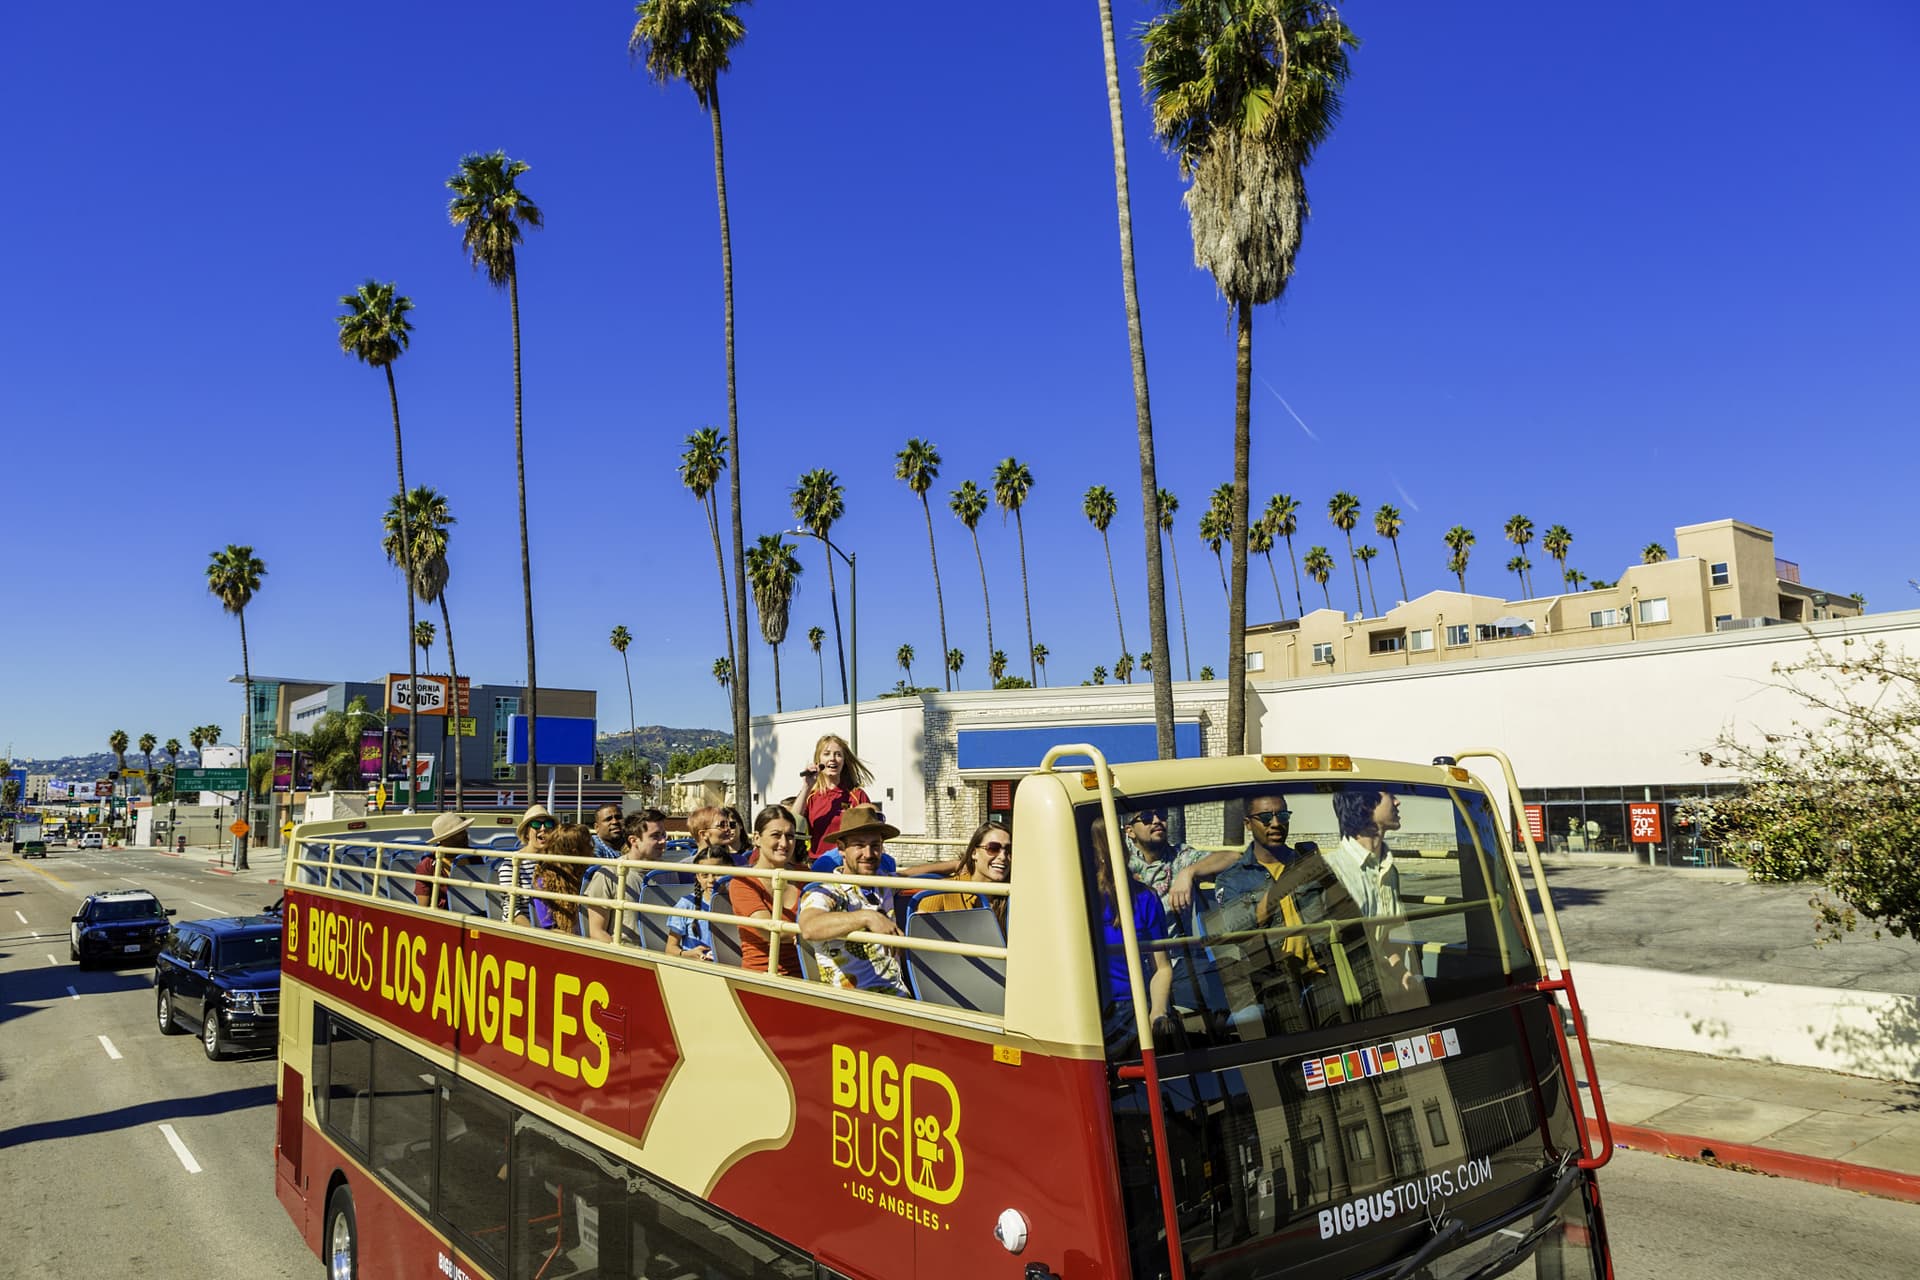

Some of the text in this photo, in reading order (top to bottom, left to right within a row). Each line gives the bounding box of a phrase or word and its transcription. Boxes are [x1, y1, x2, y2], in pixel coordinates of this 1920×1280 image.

[397, 683, 440, 692] CALORNIA
[1633, 827, 1656, 837] OFF
[381, 926, 427, 1013] LOS
[432, 942, 610, 1088] ANGELES
[832, 1043, 900, 1121] BIG
[832, 1110, 901, 1187] BUS
[852, 1180, 940, 1231] LOS ANGELES
[1318, 1155, 1493, 1240] BIGBUSTOURS.COM
